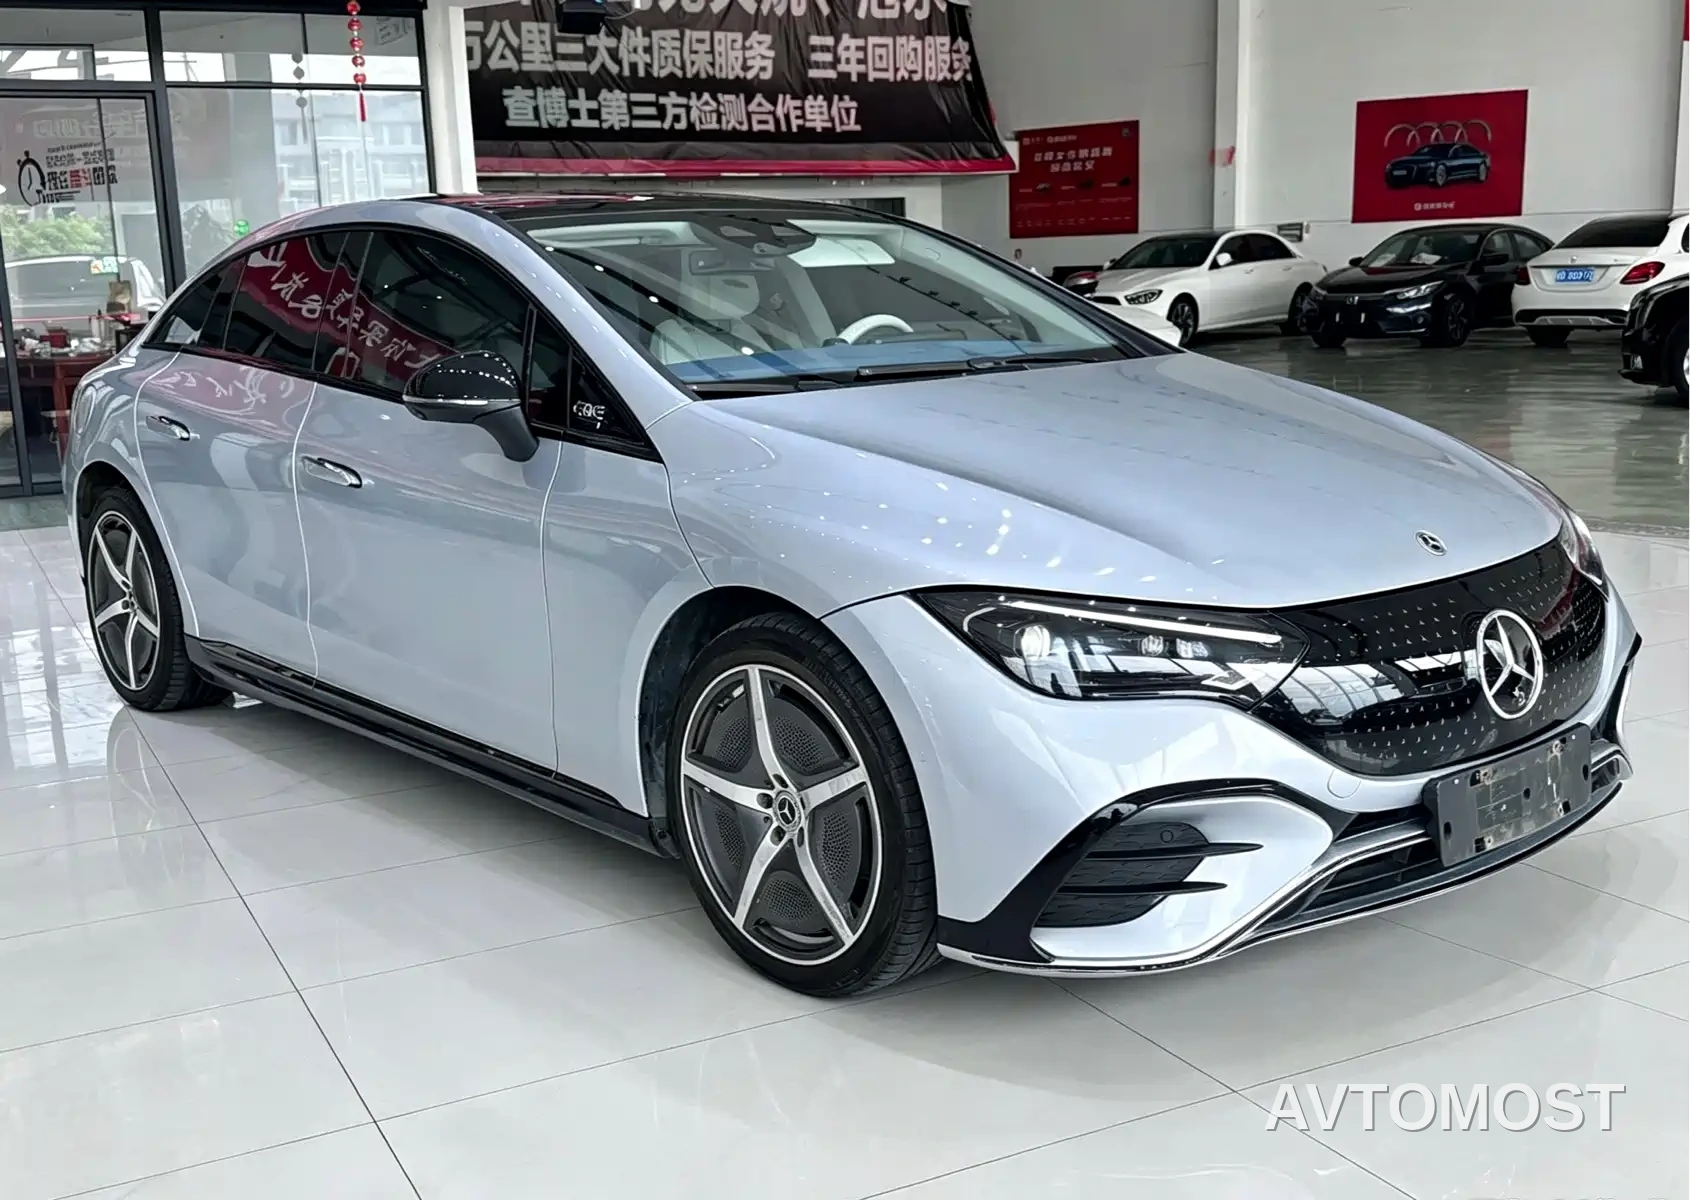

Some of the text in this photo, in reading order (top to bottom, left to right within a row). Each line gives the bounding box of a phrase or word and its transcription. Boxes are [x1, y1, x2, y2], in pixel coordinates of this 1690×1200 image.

[502, 86, 862, 133] 查博士第三方检测合作单位
